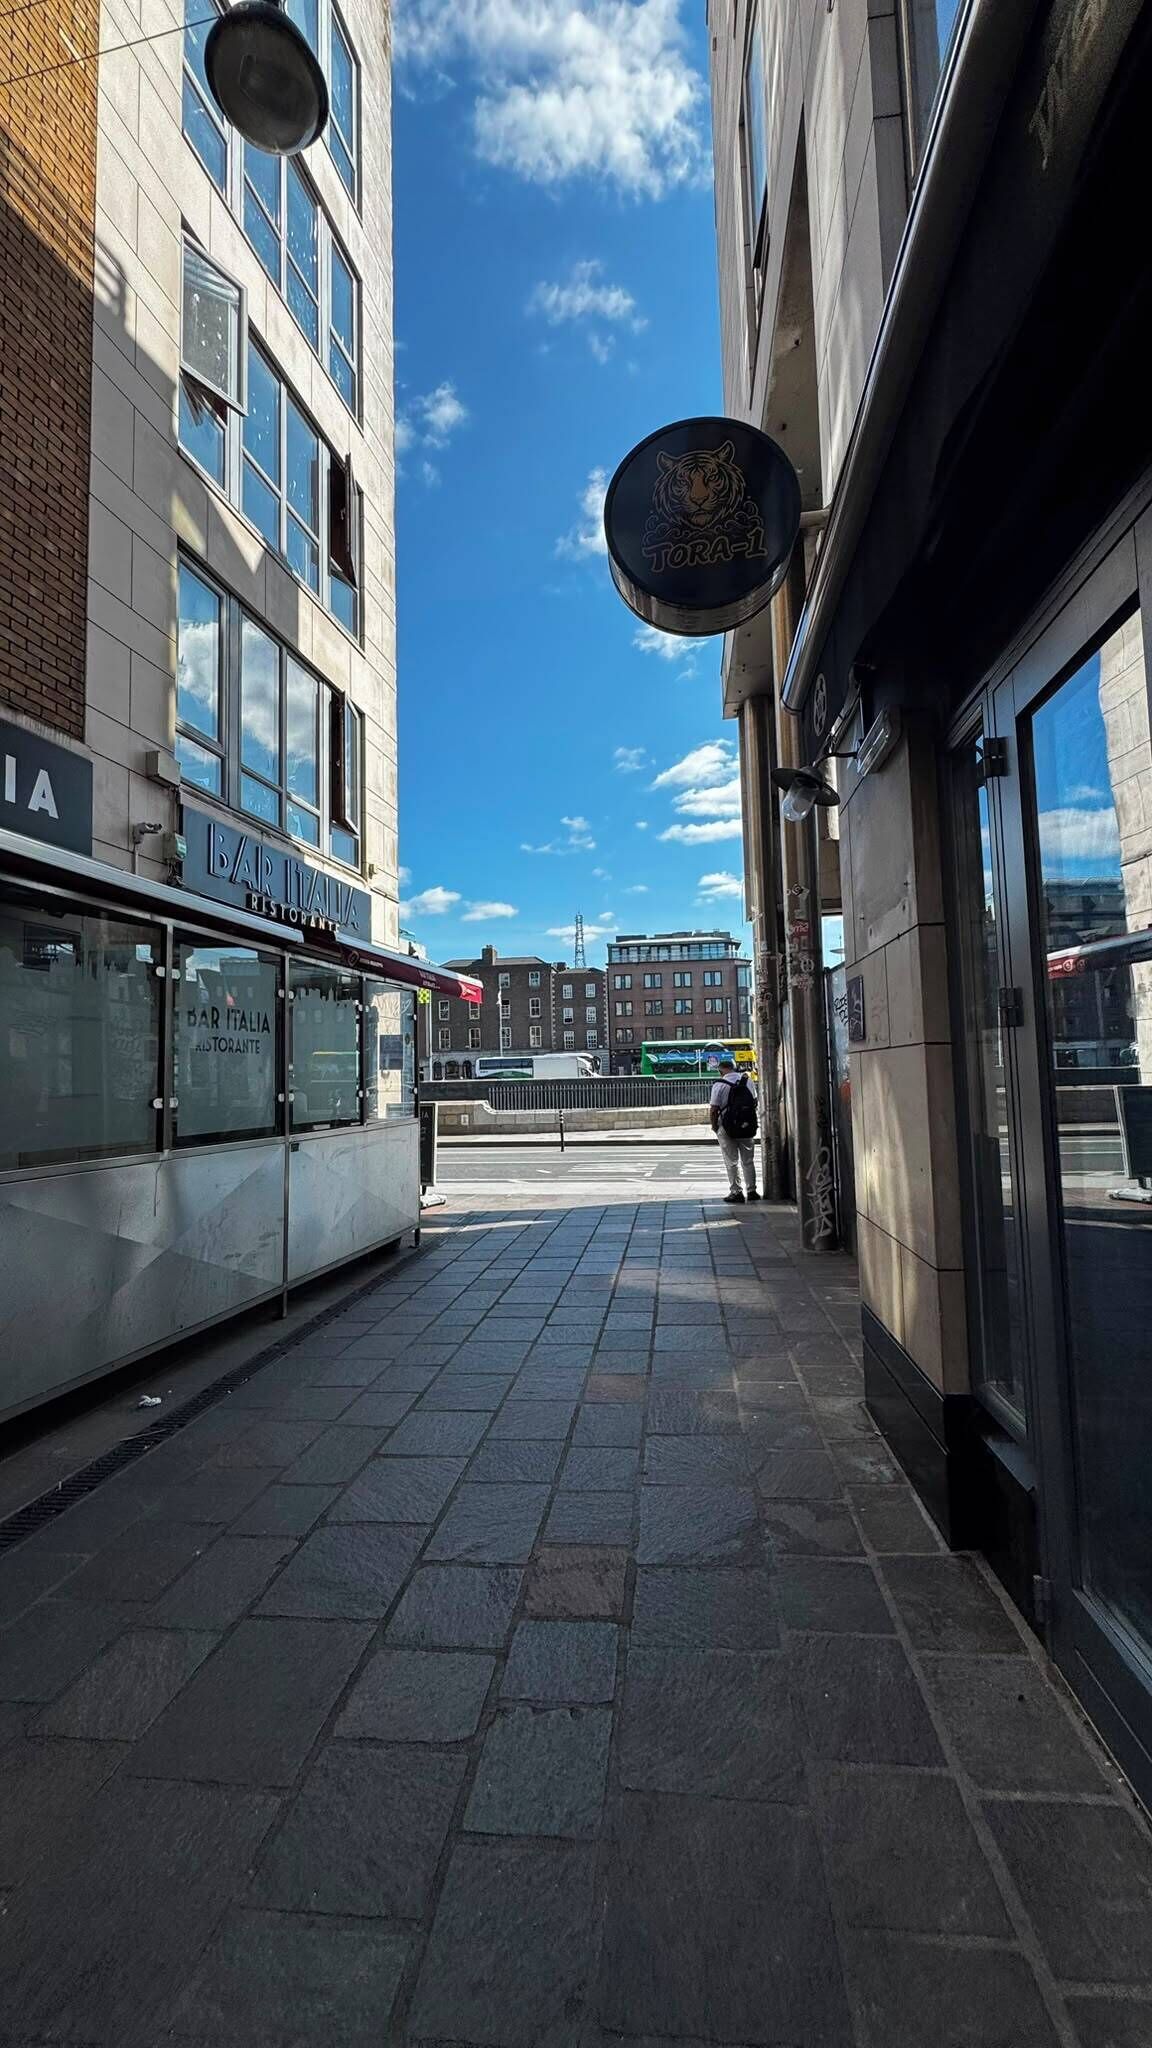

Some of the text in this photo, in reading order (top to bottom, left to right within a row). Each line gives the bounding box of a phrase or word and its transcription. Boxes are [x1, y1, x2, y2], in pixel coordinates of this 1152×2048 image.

[642, 527, 768, 572] TORA-1
[4, 753, 60, 819] IA
[207, 822, 361, 932] BAR ITALIA
[249, 893, 340, 933] RISTORANTE
[187, 1005, 271, 1034] BAR ITALIA
